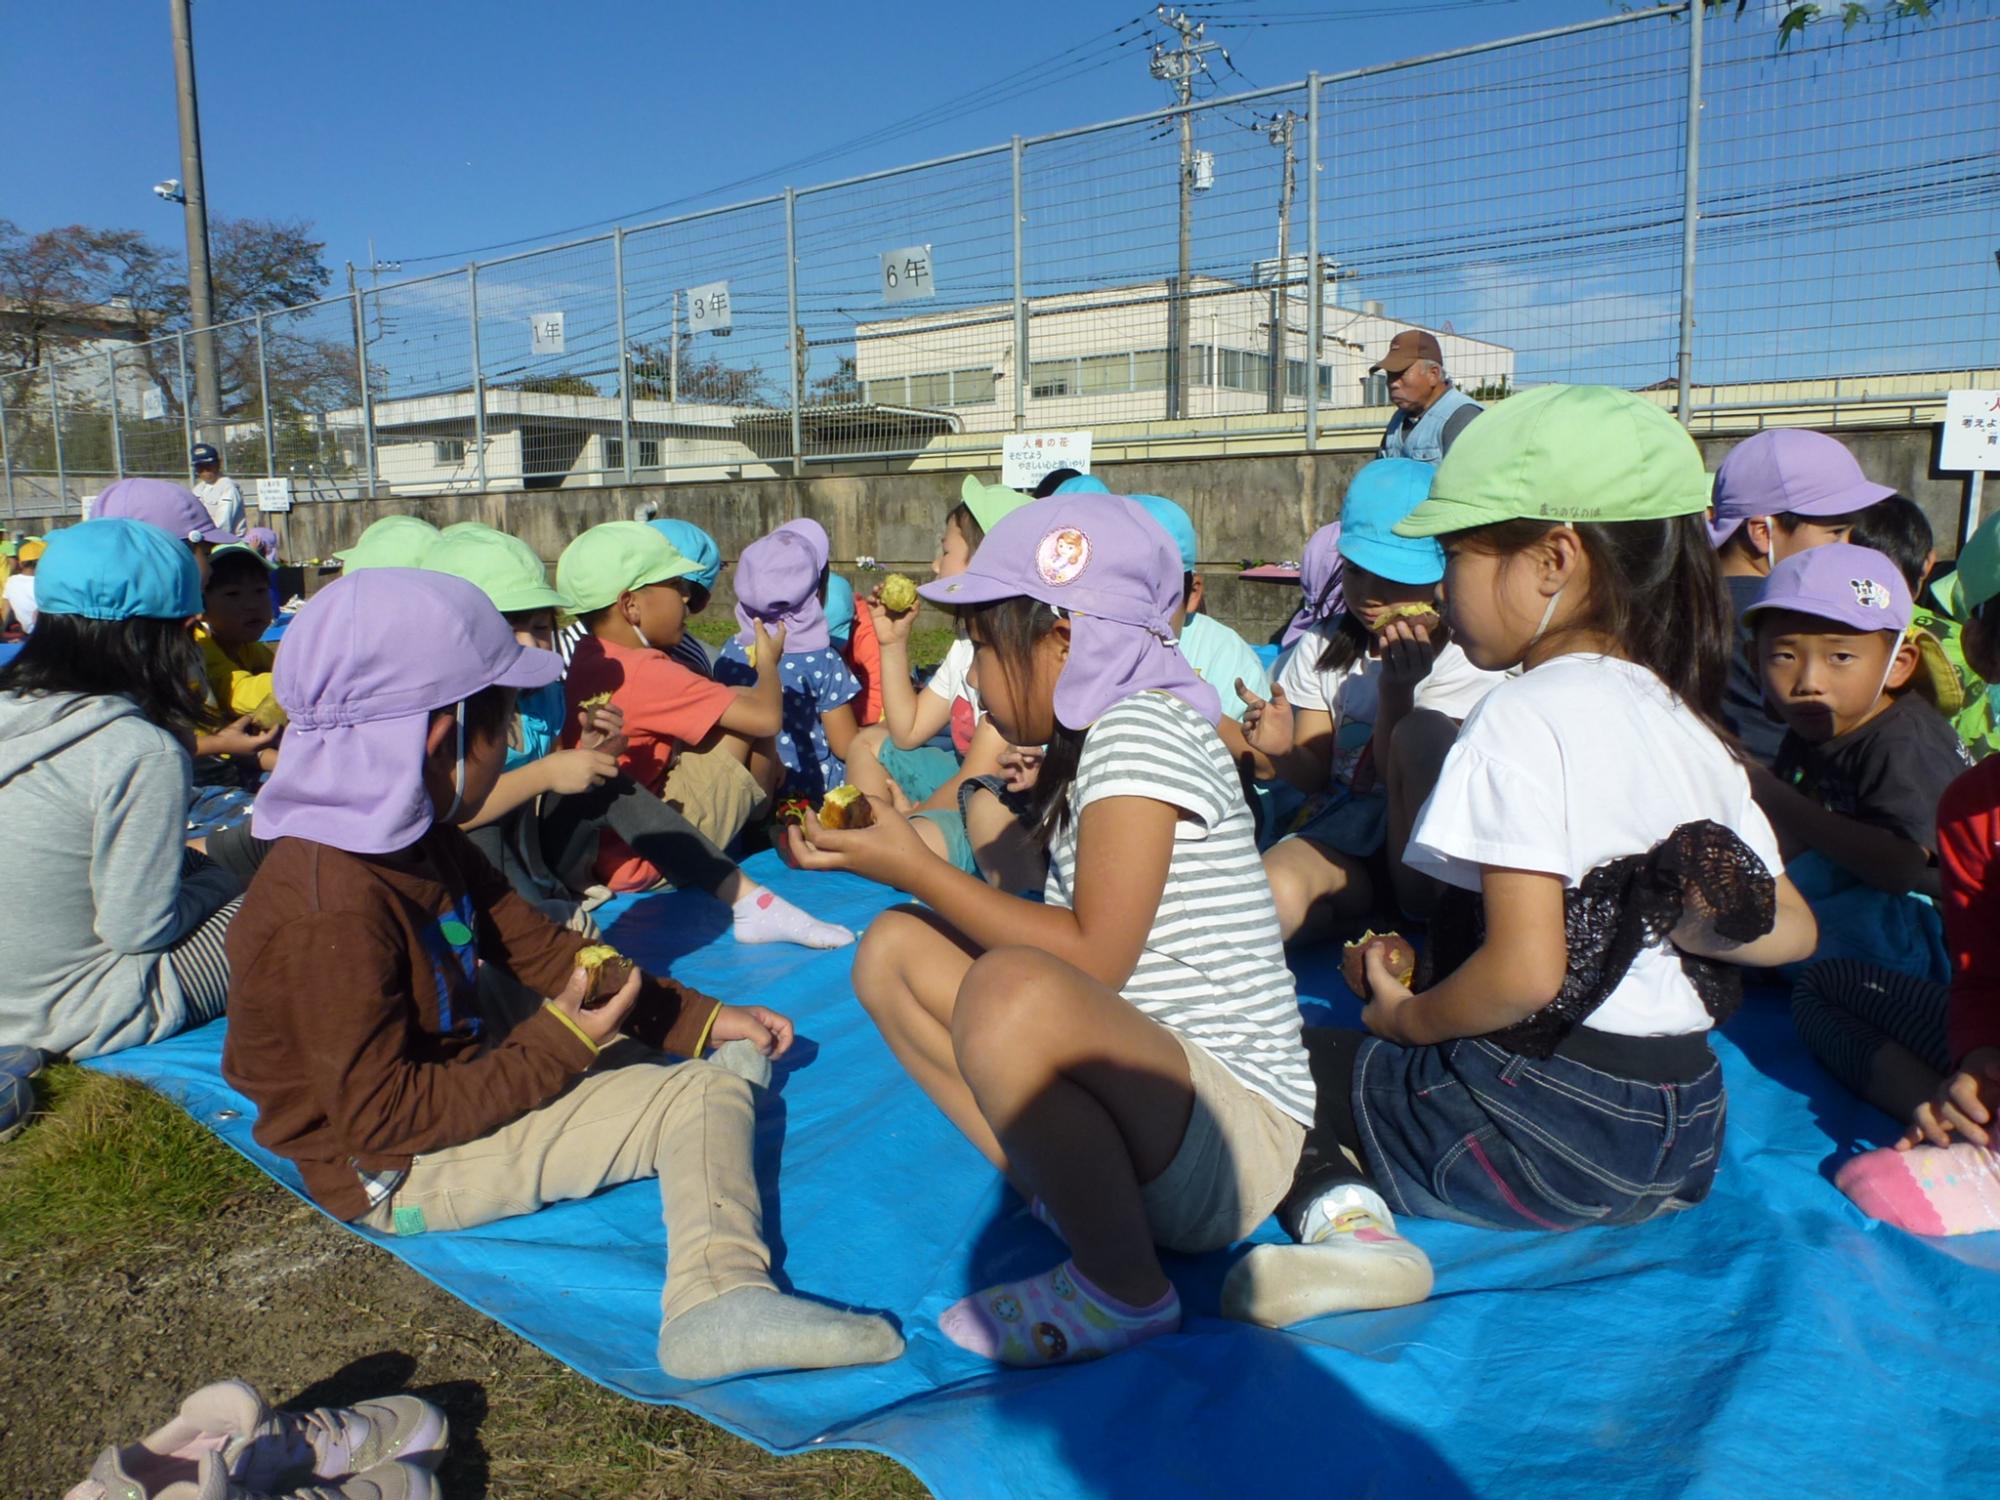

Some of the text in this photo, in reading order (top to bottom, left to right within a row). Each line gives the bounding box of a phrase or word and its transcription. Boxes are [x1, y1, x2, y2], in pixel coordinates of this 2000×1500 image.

[887, 258, 928, 288] 6年
[694, 291, 727, 319] 3年
[534, 321, 561, 344] 1年
[1023, 437, 1069, 448] 人権の花
[1009, 451, 1042, 460] そだてよう
